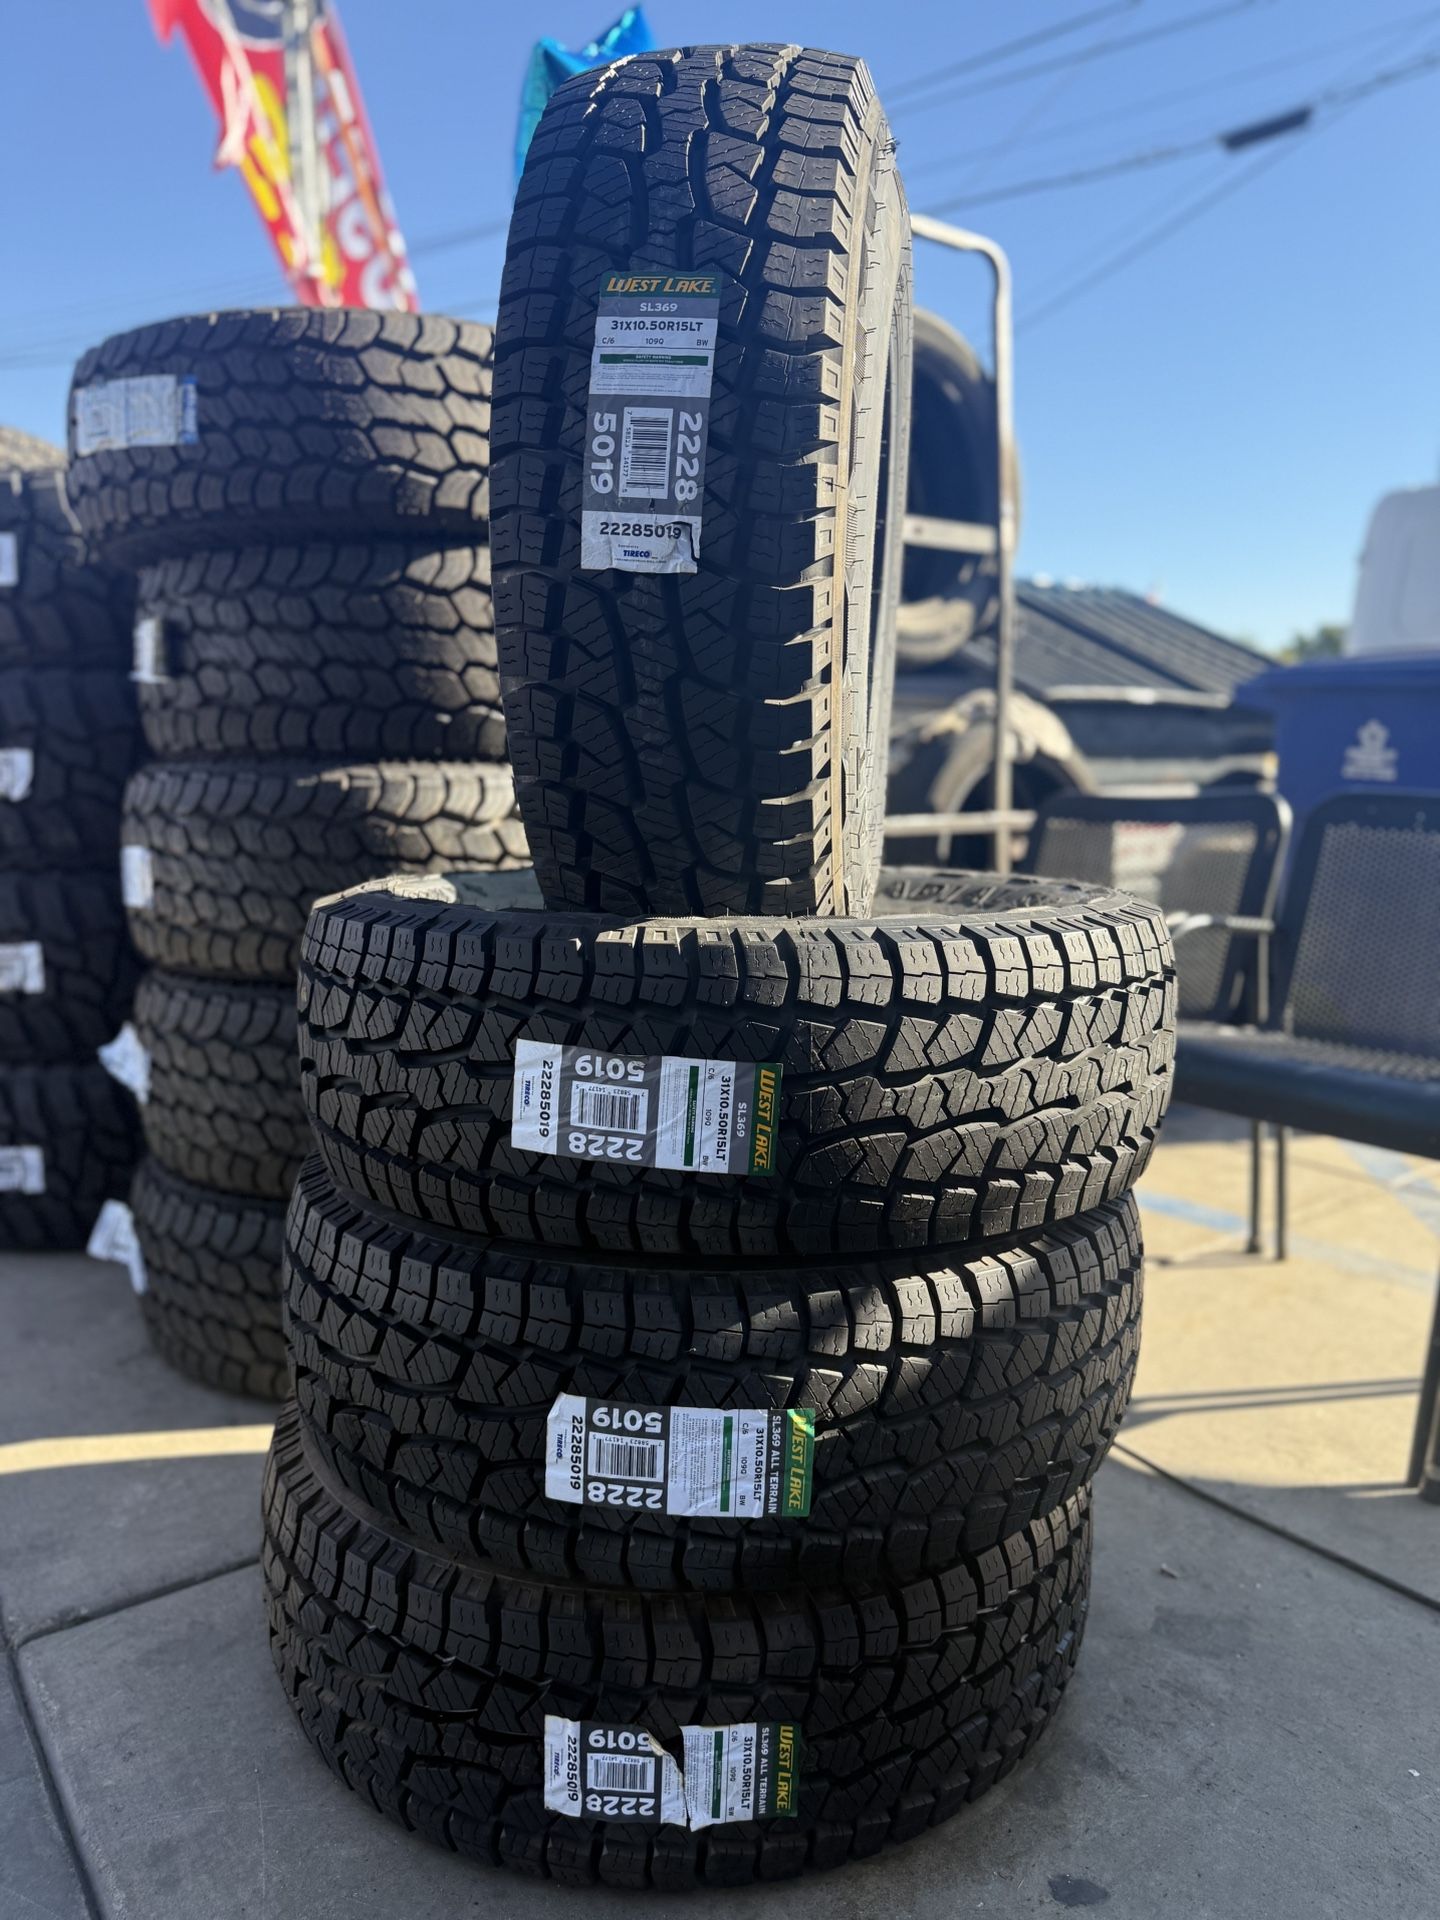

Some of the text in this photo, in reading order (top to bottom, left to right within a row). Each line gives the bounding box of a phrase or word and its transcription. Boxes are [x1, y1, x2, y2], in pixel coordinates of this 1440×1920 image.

[606, 276, 715, 293] WEST LAKE
[639, 302, 678, 312] SL369
[602, 336, 615, 345] C/6
[696, 339, 709, 347] BW
[610, 320, 704, 332] 31X10.50R15LT
[590, 412, 617, 494] 5019
[674, 411, 703, 501] 2228
[600, 521, 682, 540] 22285019
[623, 549, 650, 559] TIRECO
[575, 1055, 646, 1082] 5019
[539, 1060, 554, 1138] 22285019
[715, 1075, 731, 1161] 31X10.50R15LT
[736, 1102, 747, 1138] SL369
[754, 1069, 776, 1169] WEST LAKE
[568, 1132, 643, 1160] 2228
[592, 1407, 663, 1433] 5019
[570, 1415, 584, 1490] 22285019
[754, 1428, 764, 1501] 31X10.50R15LT
[768, 1415, 781, 1514] SL369 ALL TERRAIN
[788, 1415, 807, 1510] WEST LAKE
[587, 1482, 663, 1509] 2228
[740, 1495, 746, 1506] BW
[588, 1729, 653, 1751] 5019
[567, 1735, 579, 1802] 22285019
[741, 1736, 753, 1810] 31X10.50R15LT
[758, 1727, 770, 1815] SL369 ALL TERRAIN
[776, 1725, 794, 1810] WEST LAKE
[586, 1794, 655, 1816] 2228
